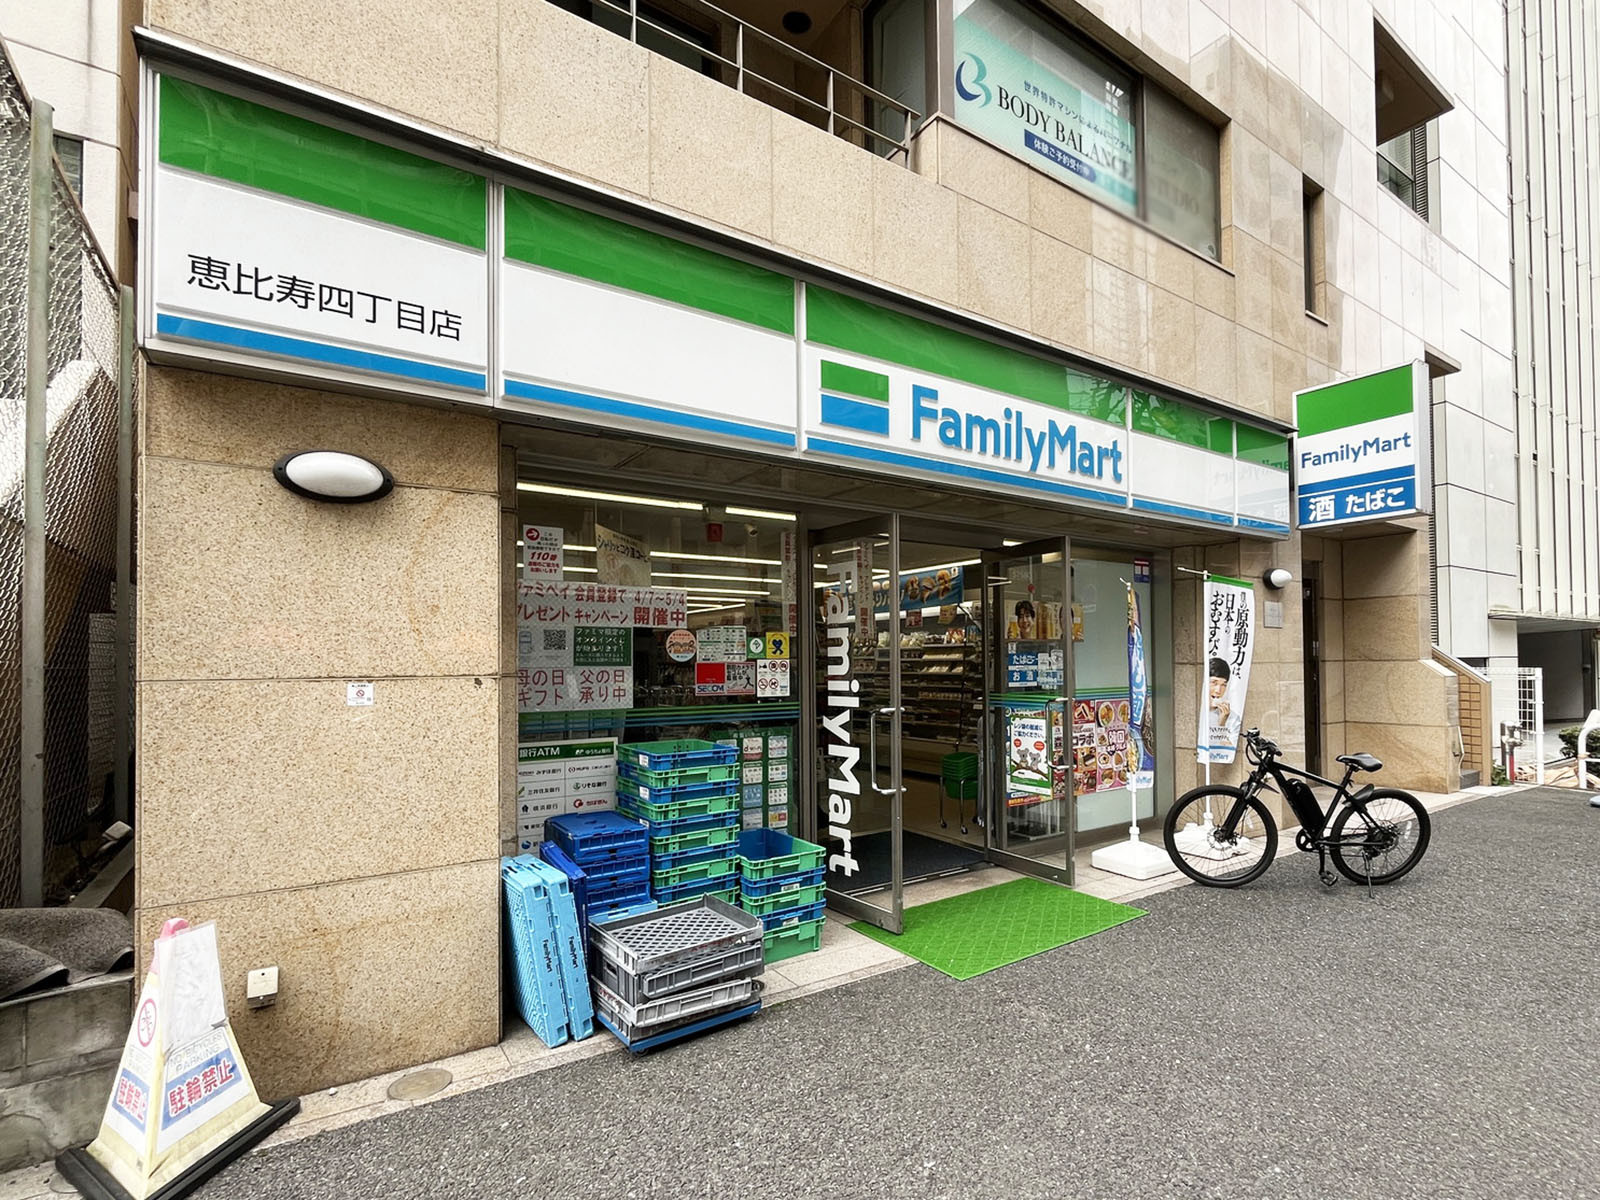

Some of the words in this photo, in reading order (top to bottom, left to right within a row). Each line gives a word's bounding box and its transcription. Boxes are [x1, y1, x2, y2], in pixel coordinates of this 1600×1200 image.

[997, 85, 1051, 135] BODY
[187, 253, 462, 342] 恵比寿四丁目店
[911, 383, 1123, 484] FamilyMart
[1301, 431, 1412, 469] FamilyMart
[1309, 494, 1336, 523] 酒
[1345, 486, 1406, 516] たばこ
[574, 607, 629, 625] キャンペーン
[633, 606, 686, 627] 開催中
[1223, 592, 1236, 635] 日本の
[518, 669, 564, 687] 母の日
[580, 669, 625, 685] 父の日
[518, 687, 564, 707] ギフト
[579, 686, 626, 705] 承り中
[697, 684, 724, 693] SECOM
[822, 560, 861, 878] FamilyMart
[1072, 732, 1095, 749] コラボ
[168, 1058, 235, 1116] 駐輪禁止
